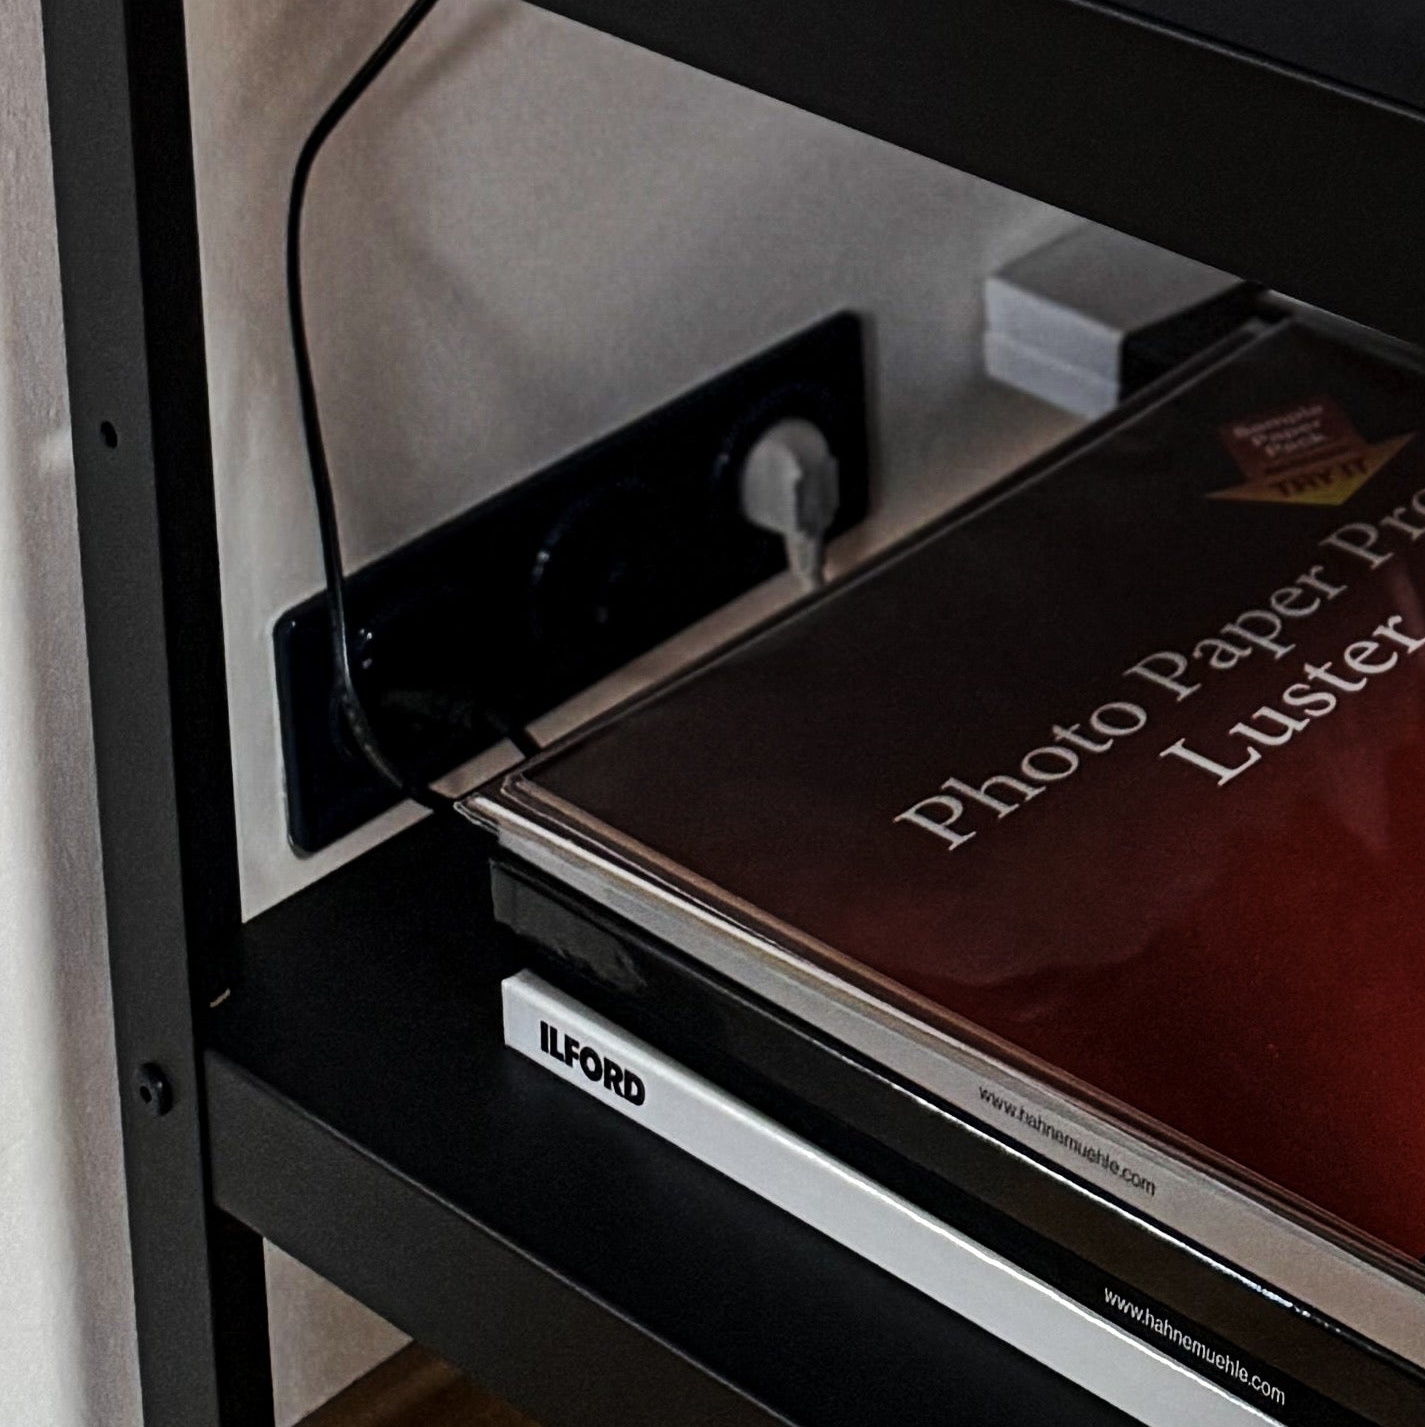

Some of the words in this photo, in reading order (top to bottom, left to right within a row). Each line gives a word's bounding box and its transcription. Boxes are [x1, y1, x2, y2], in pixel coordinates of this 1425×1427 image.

[1232, 405, 1323, 438] Sample
[1251, 420, 1320, 446] Paper
[1264, 433, 1328, 457] Pack
[892, 697, 1150, 852] Photo
[1122, 545, 1347, 703] Paper
[539, 1019, 647, 1108] ILFORD
[978, 1084, 1157, 1197] www.hahnemuehle.com
[1103, 1285, 1287, 1408] www.hahnemuehle.com
